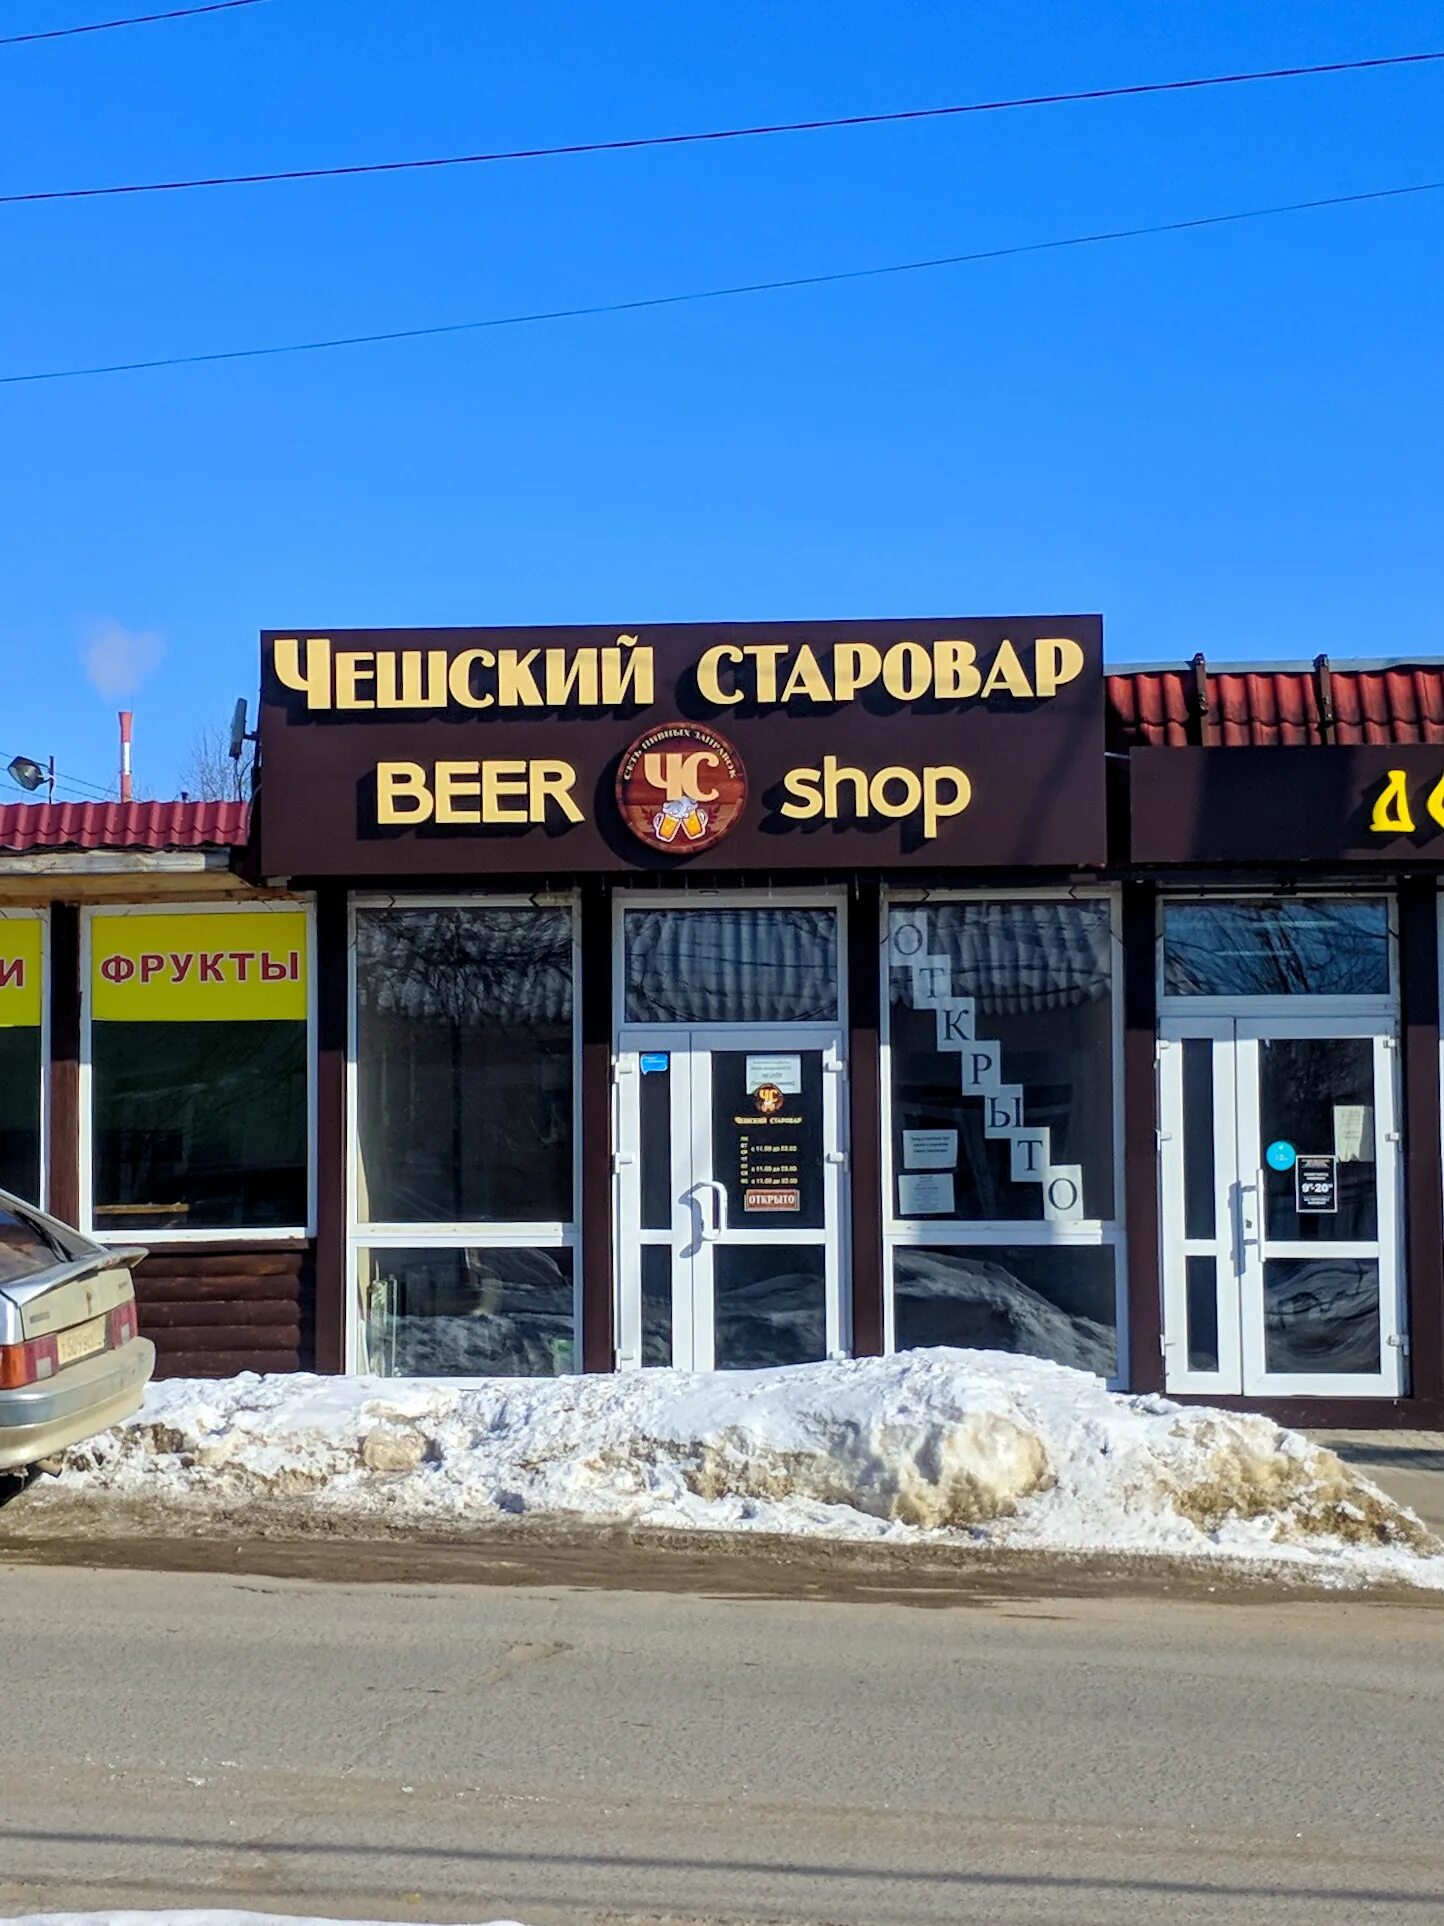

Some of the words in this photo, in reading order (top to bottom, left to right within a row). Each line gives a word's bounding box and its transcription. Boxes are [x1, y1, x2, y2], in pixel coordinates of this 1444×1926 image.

[273, 634, 655, 711] ЧЕШСКИЙ
[697, 638, 1085, 706] СТАРОВАР
[641, 728, 691, 750] ПИВНЫХ
[693, 730, 737, 779] ЗАПРАВОК
[644, 751, 720, 802] ЧС
[376, 759, 586, 825] BEER
[780, 754, 973, 839] shop
[100, 951, 299, 984] ФРУКТЫ
[748, 1193, 796, 1205] ОТКРЫТО
